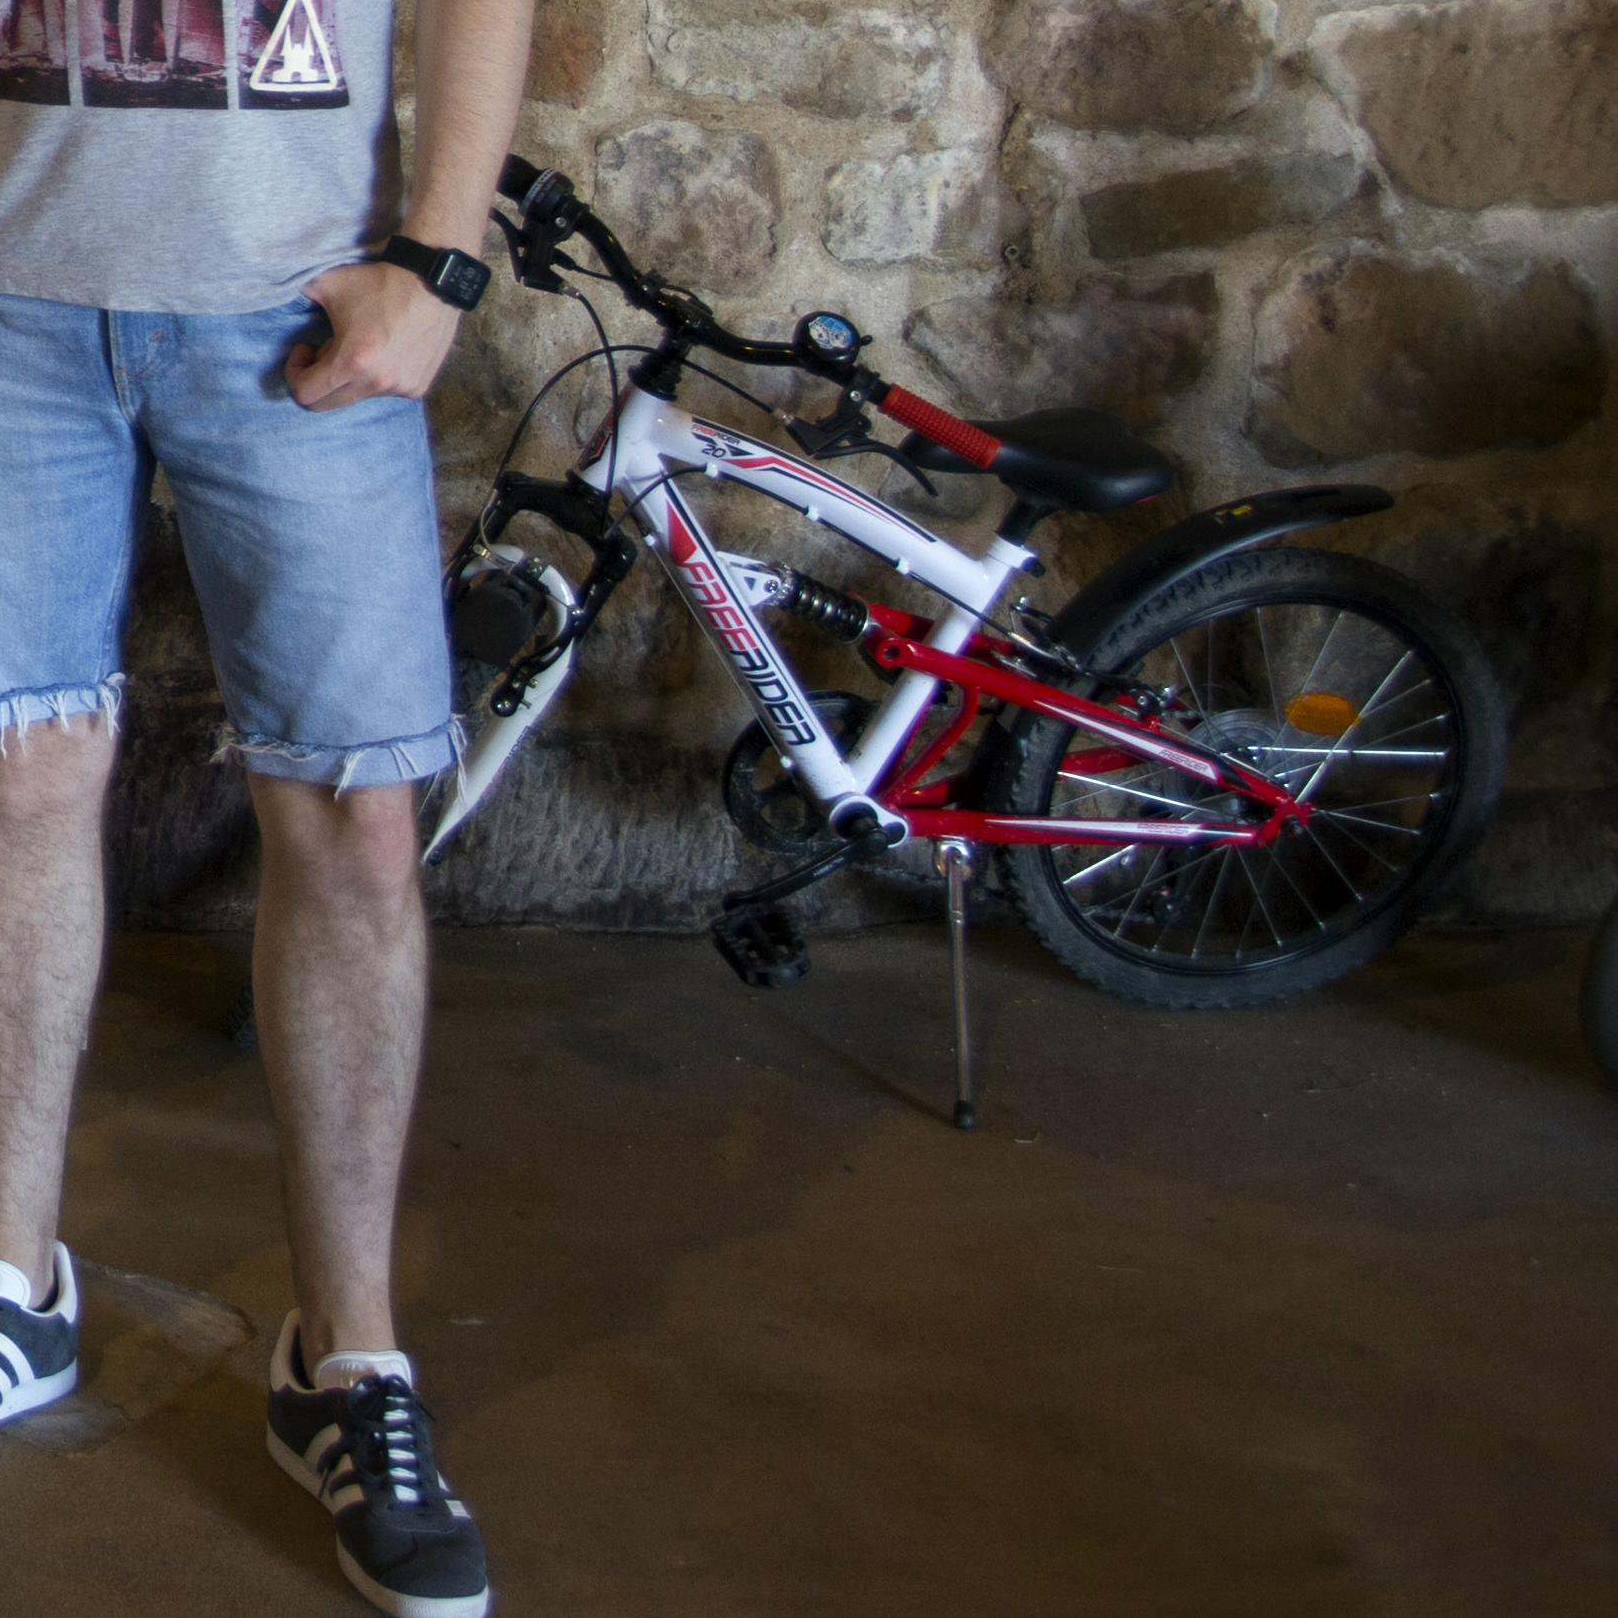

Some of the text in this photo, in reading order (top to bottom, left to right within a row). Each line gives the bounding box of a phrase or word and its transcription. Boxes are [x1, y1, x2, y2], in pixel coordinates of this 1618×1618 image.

[690, 422, 741, 446] FREERIDER
[700, 443, 727, 459] 20
[676, 560, 817, 747] FREERIDER
